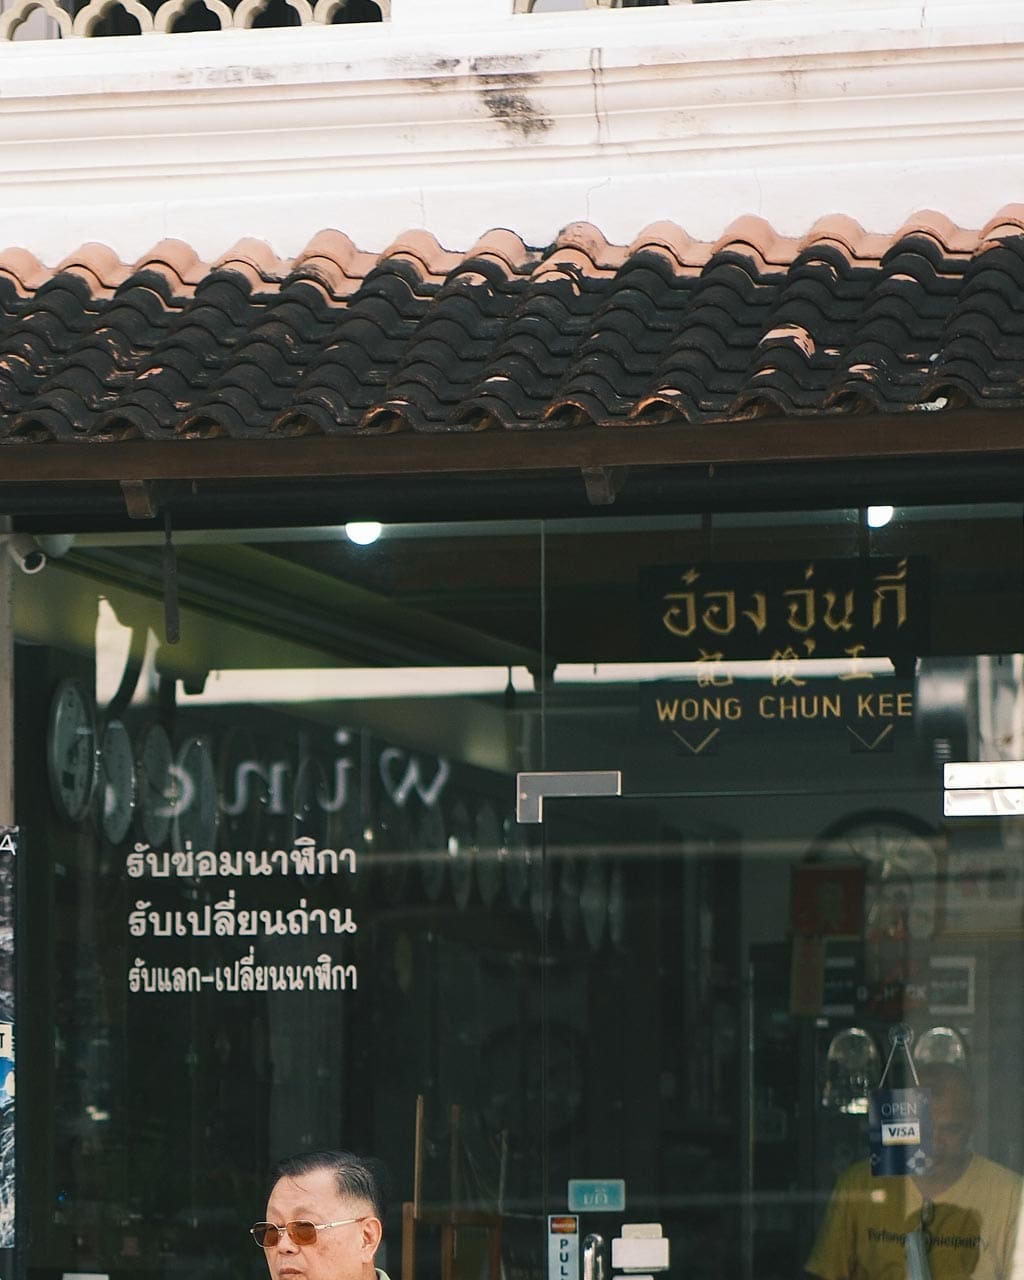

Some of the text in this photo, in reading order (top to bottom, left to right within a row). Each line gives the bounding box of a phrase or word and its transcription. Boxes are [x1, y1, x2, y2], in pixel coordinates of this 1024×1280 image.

[656, 693, 913, 721] WONG CHUN KEE
[127, 836, 357, 878] รับซ่อมนาฬิกา
[129, 889, 358, 937] รับเปลี่ยนถ่าน
[129, 946, 358, 993] รับแลก-เปลี่ยนนาฬิกา
[881, 1102, 917, 1116] OPEN
[887, 1126, 916, 1138] VISA
